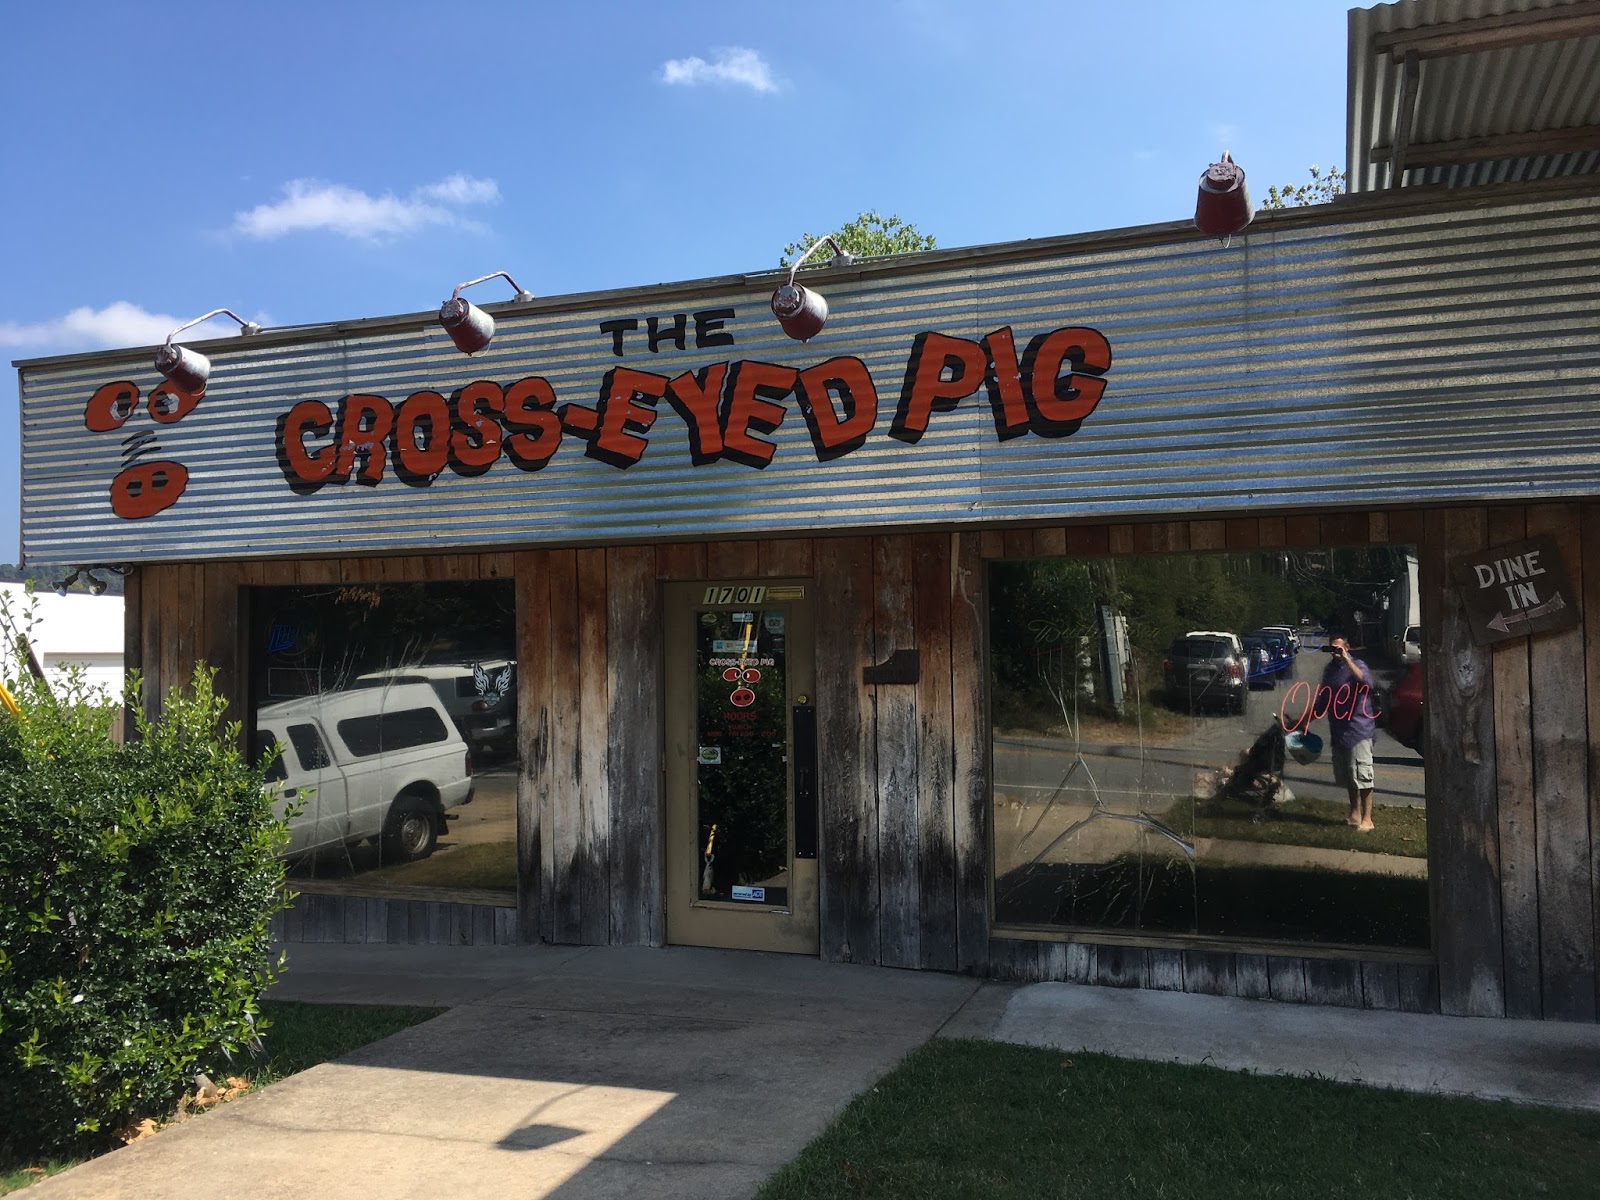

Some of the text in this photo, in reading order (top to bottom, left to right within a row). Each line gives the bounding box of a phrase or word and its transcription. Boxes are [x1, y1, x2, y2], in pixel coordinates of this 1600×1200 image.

[600, 308, 736, 357] THE
[276, 325, 1113, 496] CROSS-EYED PIG
[1473, 550, 1546, 589] DINE
[706, 587, 762, 603] 1701
[1505, 581, 1541, 610] IN
[709, 657, 759, 667] CROSS-EED
[1280, 681, 1382, 736] Open
